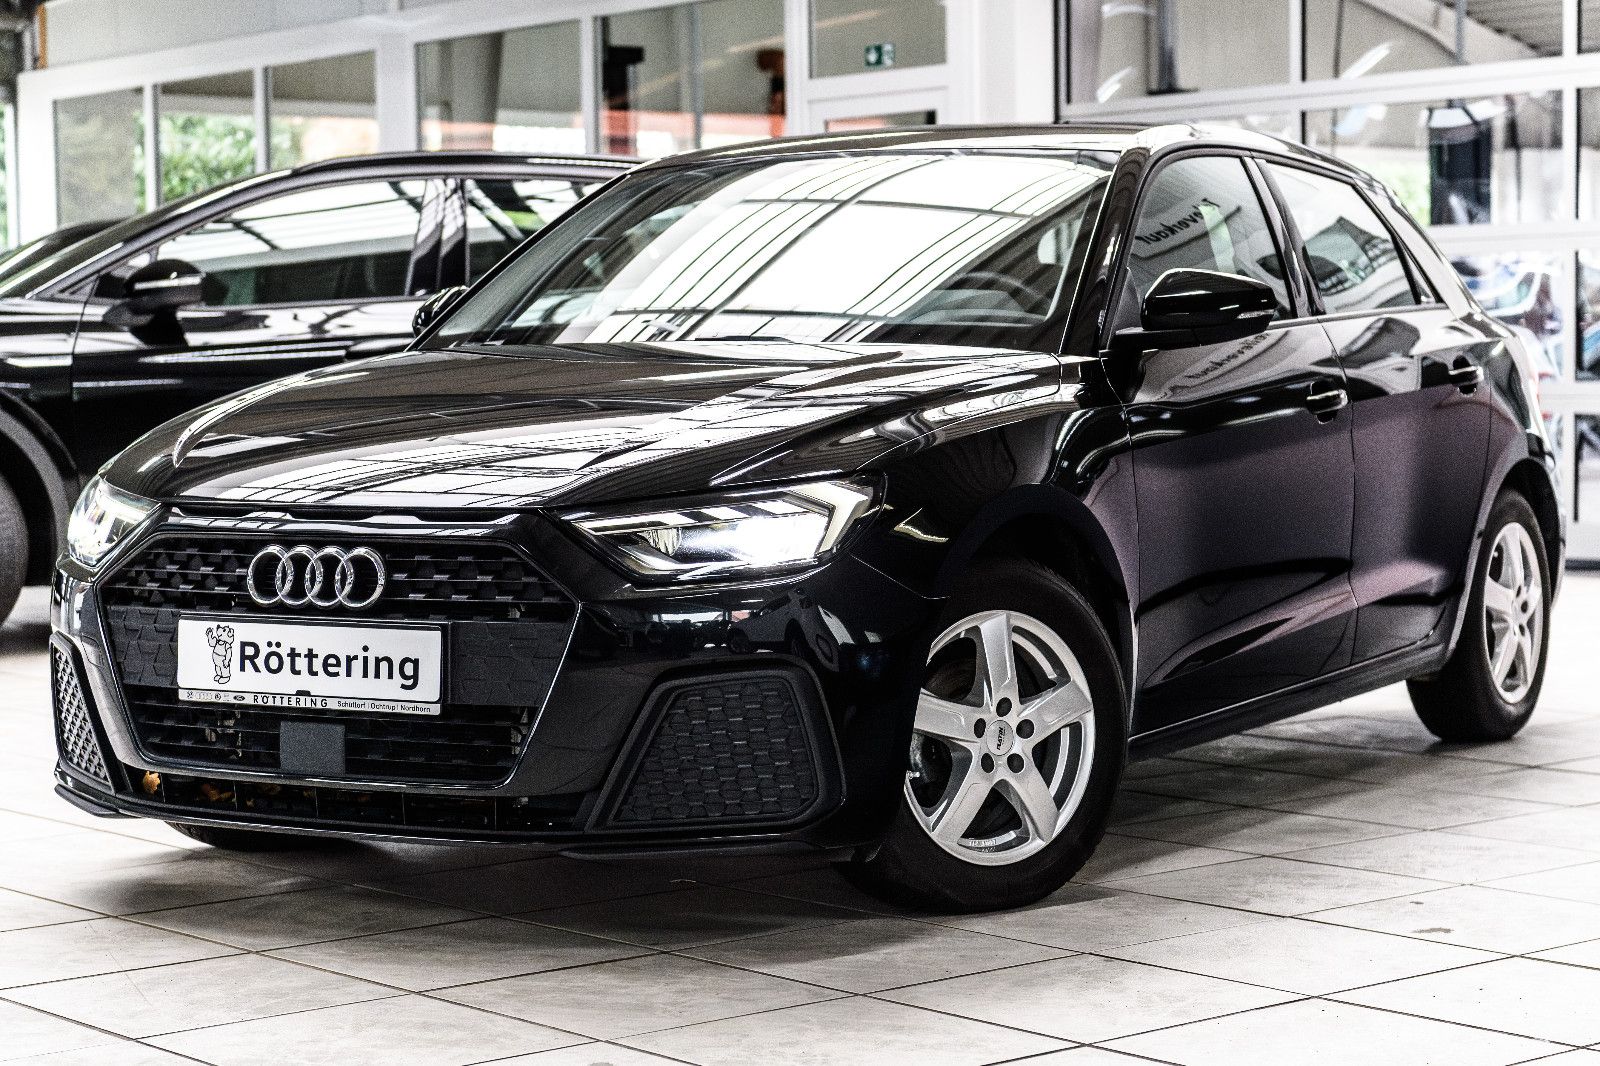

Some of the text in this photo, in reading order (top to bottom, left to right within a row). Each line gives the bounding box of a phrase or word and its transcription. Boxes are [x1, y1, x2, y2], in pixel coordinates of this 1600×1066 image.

[239, 640, 420, 691] Röttering
[253, 694, 328, 708] RÖTTERING
[400, 704, 431, 713] Nordhorn
